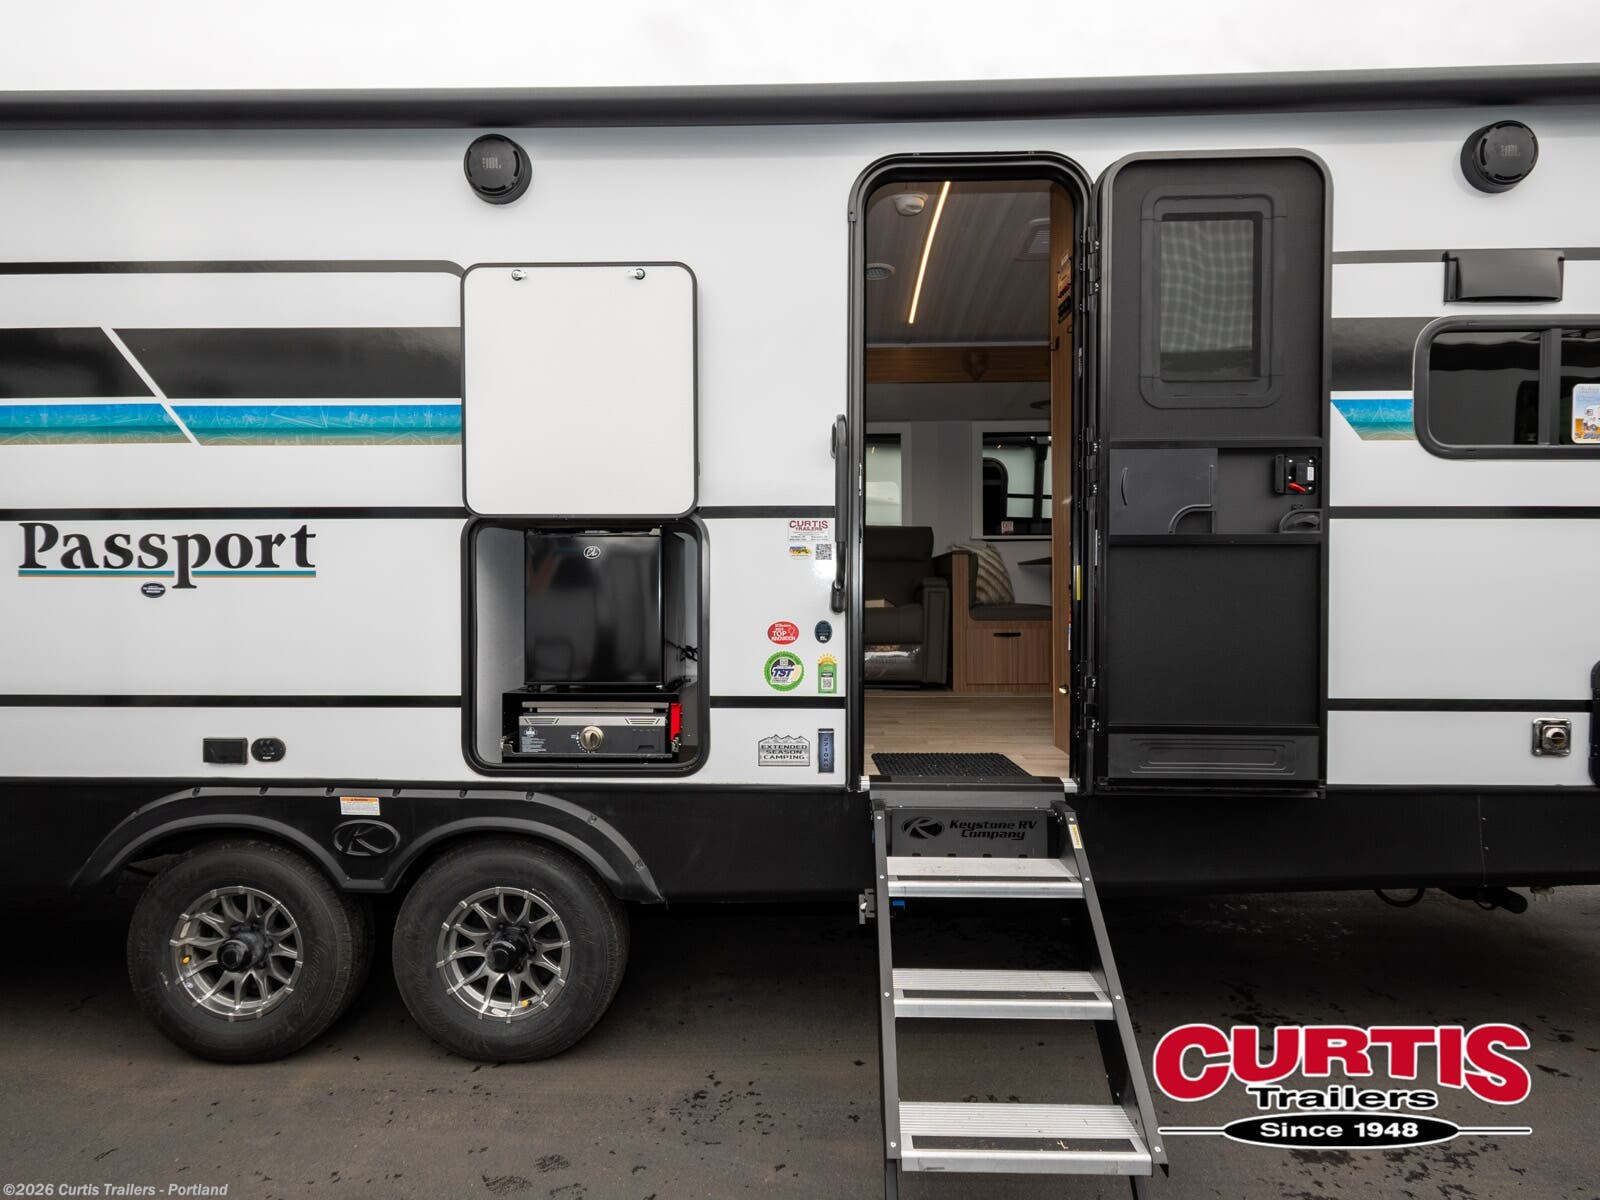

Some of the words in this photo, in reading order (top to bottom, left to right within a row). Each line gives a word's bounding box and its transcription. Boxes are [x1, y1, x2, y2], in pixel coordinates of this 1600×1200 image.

[789, 520, 828, 529] CURTIS
[18, 522, 316, 589] Passport
[773, 668, 794, 677] TST
[949, 820, 1016, 830] Keystone
[1018, 820, 1038, 829] RV
[961, 829, 1026, 841] Company
